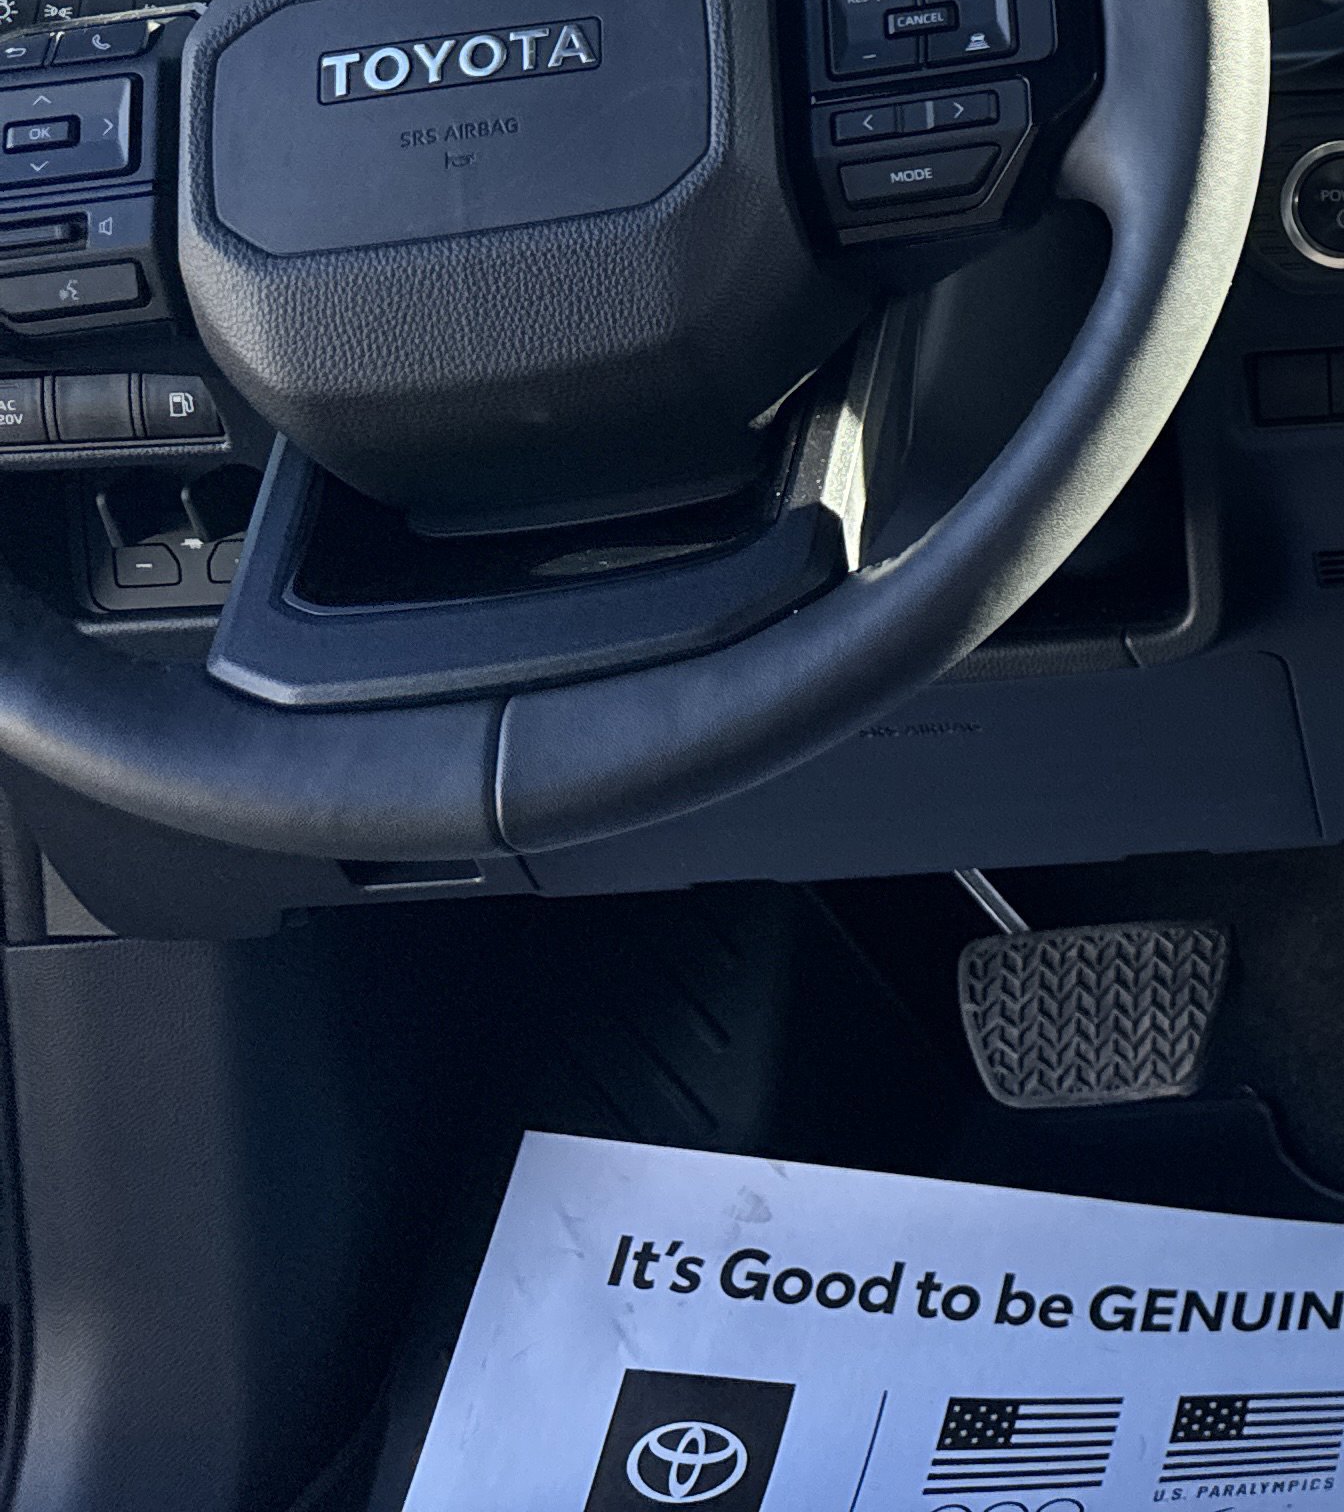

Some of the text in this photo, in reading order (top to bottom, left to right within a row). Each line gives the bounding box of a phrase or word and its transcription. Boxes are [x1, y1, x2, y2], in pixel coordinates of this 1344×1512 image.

[897, 12, 945, 28] CANCEL
[321, 24, 597, 98] TOYOTA
[29, 127, 51, 140] OK
[400, 116, 519, 149] SRS AIRBAG
[889, 167, 933, 184] MODE
[720, 1248, 906, 1315] Good
[916, 1271, 982, 1321] to
[994, 1272, 1074, 1329] be
[1153, 1477, 1335, 1503] U.S. PARALYMPICS
